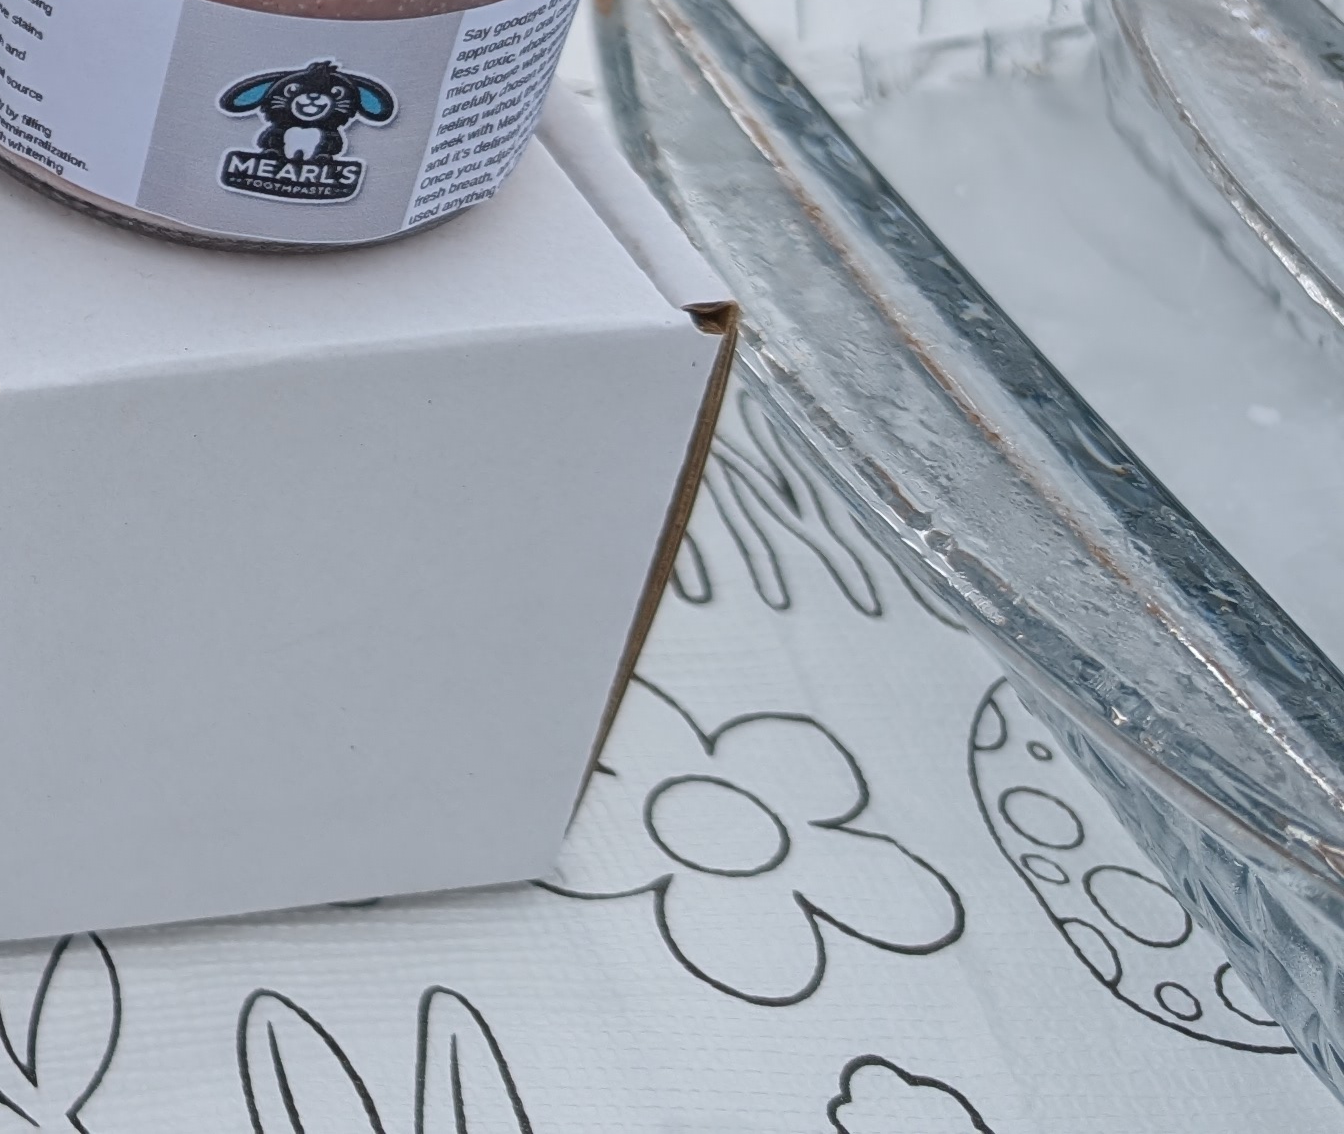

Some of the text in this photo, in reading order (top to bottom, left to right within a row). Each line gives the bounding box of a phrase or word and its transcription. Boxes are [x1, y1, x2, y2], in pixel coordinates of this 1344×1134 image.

[12, 15, 43, 41] stains
[462, 26, 493, 42] Say
[5, 42, 27, 61] and
[456, 32, 521, 62] approach
[450, 64, 480, 81] less
[6, 75, 43, 102] source
[5, 104, 19, 121] by
[441, 91, 498, 118] carefully
[430, 133, 465, 155] week
[7, 138, 64, 176] whitening
[424, 152, 450, 173] and
[227, 155, 359, 185] MEARL'S
[420, 160, 483, 190] Once you
[245, 178, 333, 195] TOOTHPASTE
[413, 186, 446, 208] fresh
[408, 185, 496, 226] used anything
